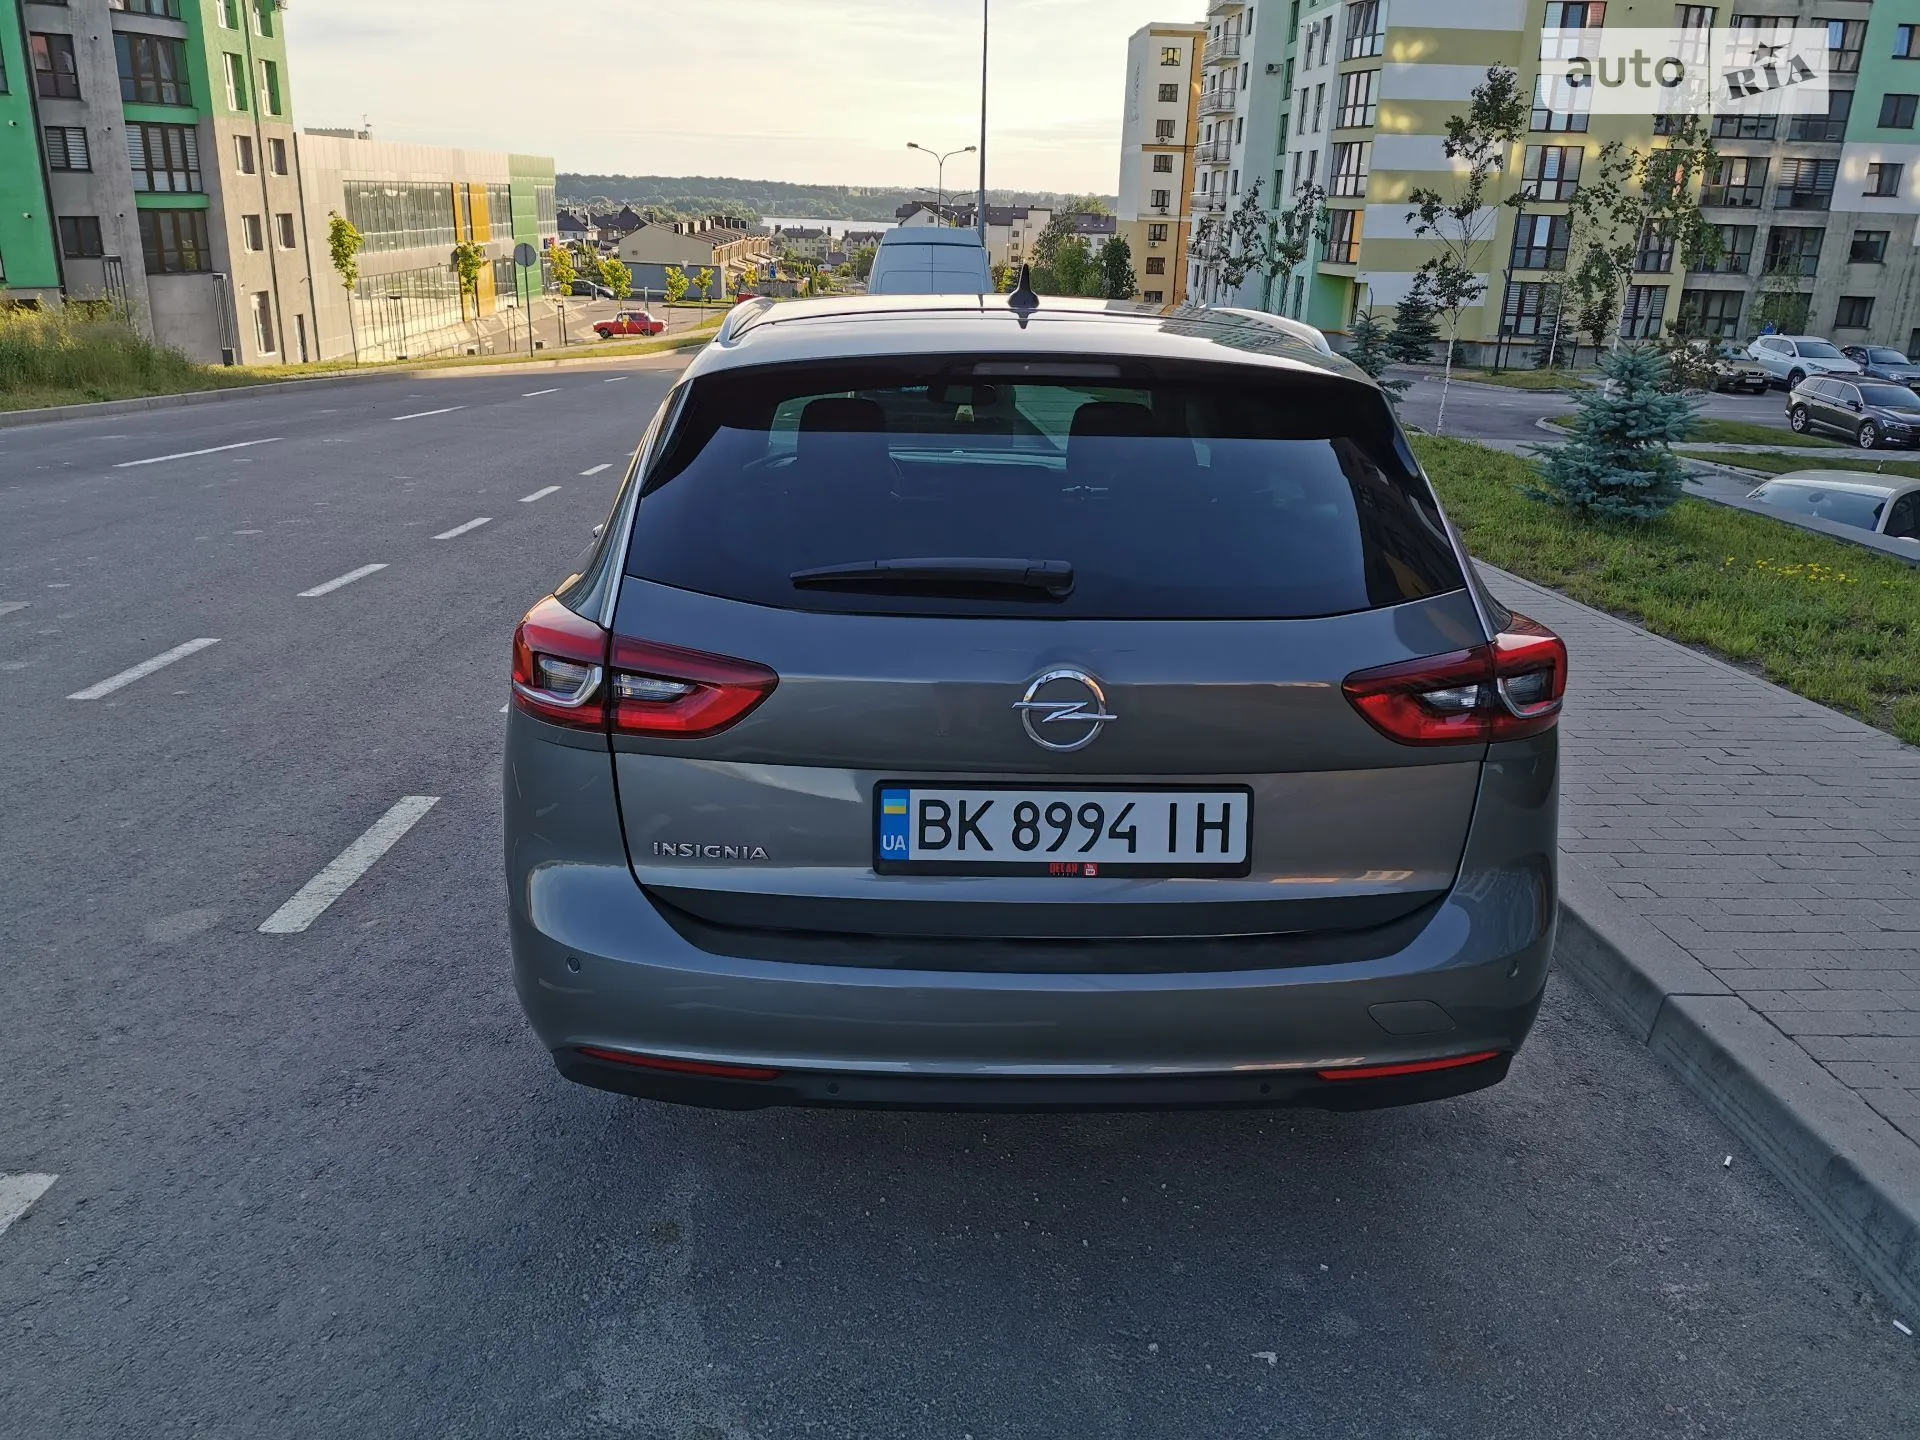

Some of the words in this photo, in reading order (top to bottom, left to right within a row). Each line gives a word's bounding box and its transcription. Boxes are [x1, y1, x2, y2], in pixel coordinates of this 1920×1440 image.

[918, 799, 995, 852] BK
[1011, 801, 1137, 853] 8994
[1168, 802, 1231, 853] IH
[652, 842, 769, 860] INSIGNIA
[882, 834, 906, 851] UA
